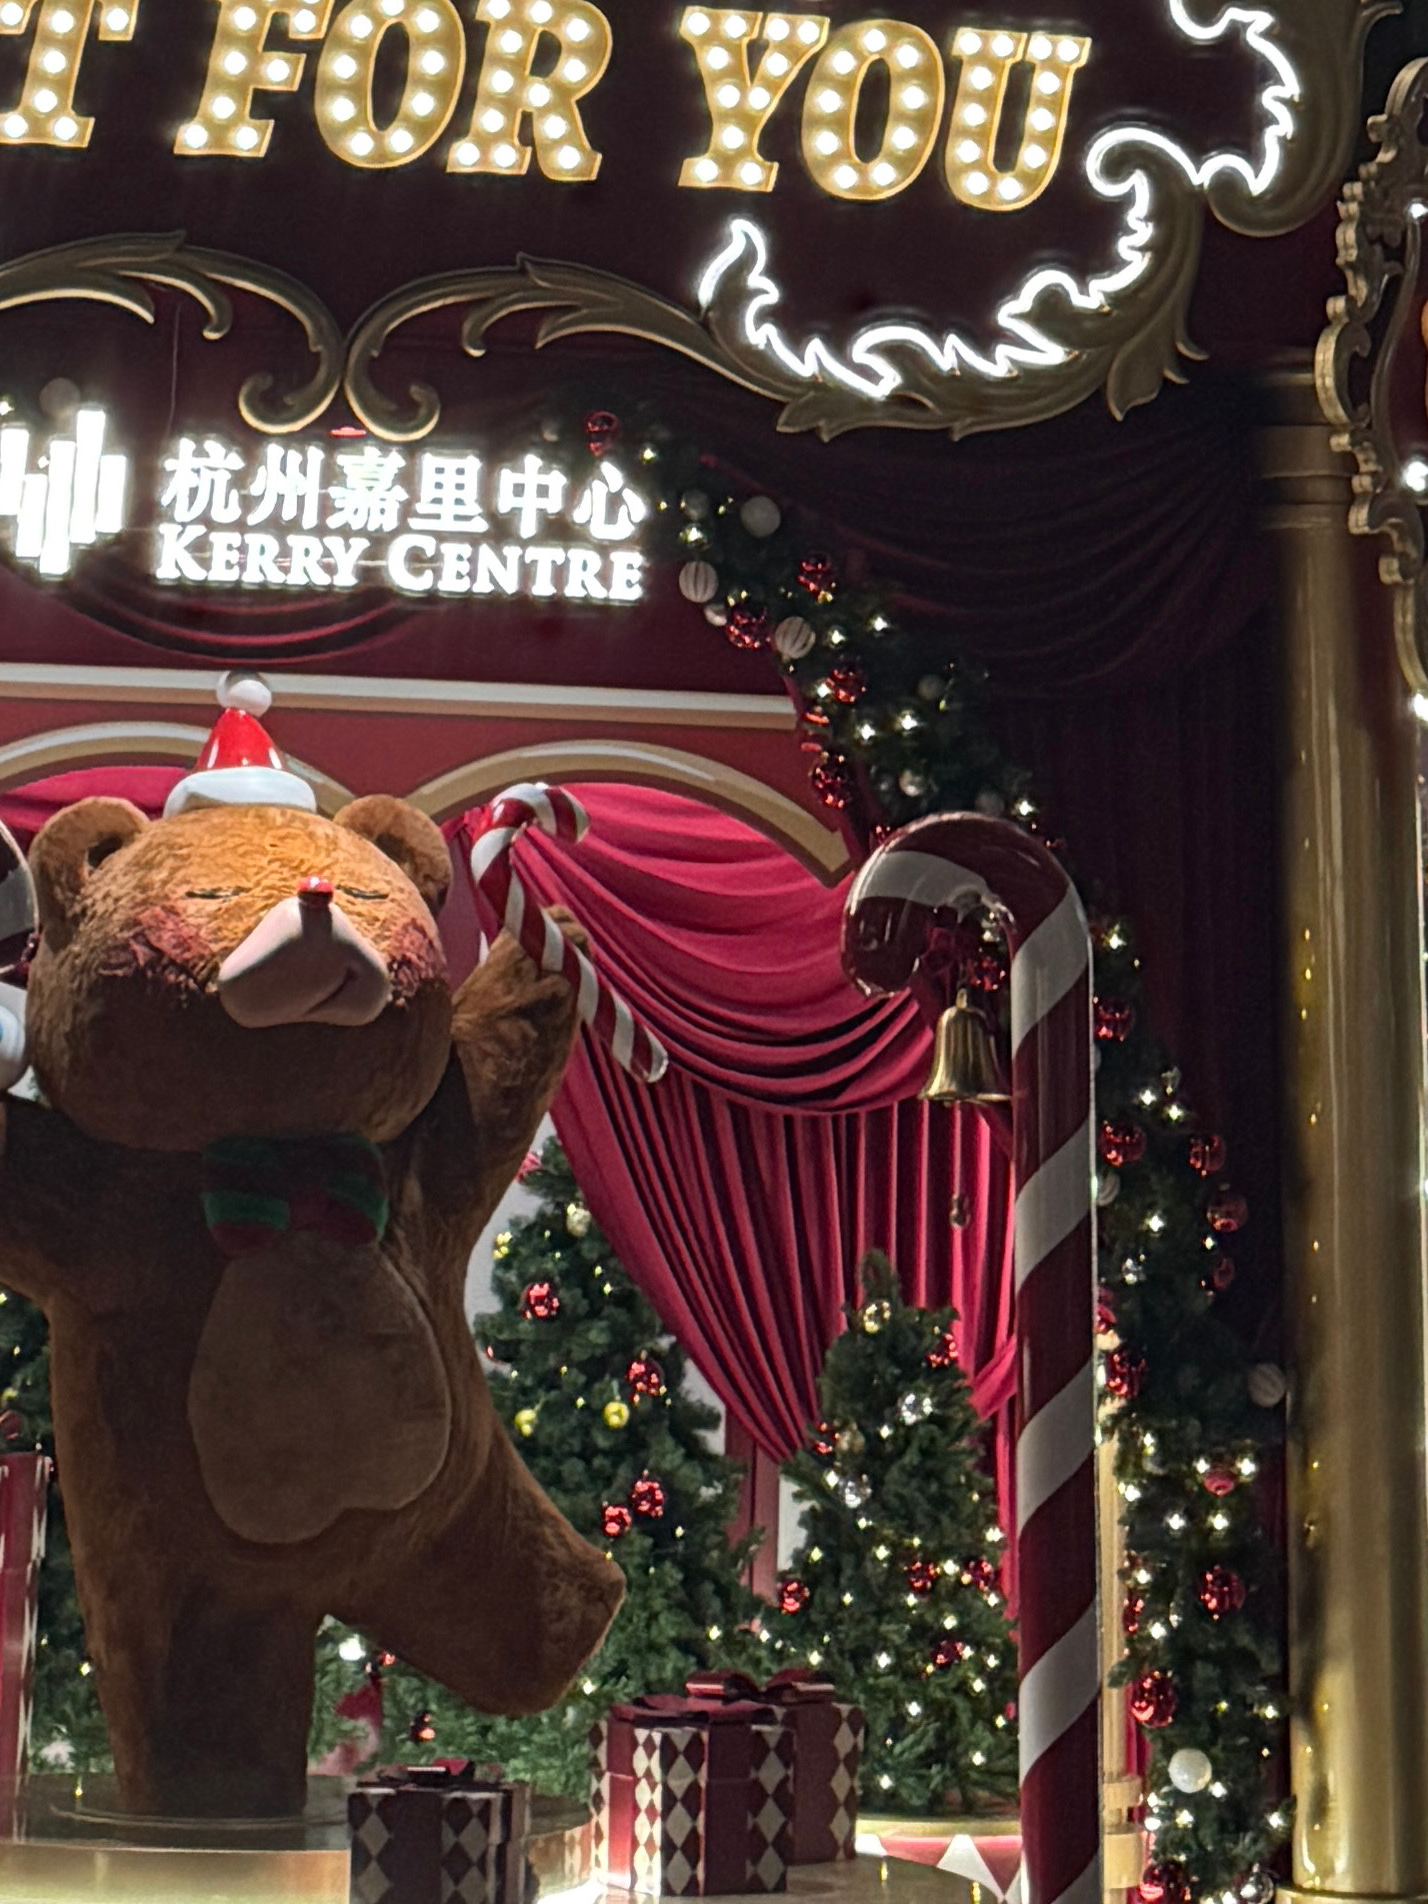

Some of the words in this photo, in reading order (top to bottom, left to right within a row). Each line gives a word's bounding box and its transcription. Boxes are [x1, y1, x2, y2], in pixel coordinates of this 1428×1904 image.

[675, 5, 1094, 213] YOU
[158, 436, 650, 542] 杭州嘉里中心
[154, 521, 364, 591] KERRY
[386, 532, 647, 603] CENTRE
